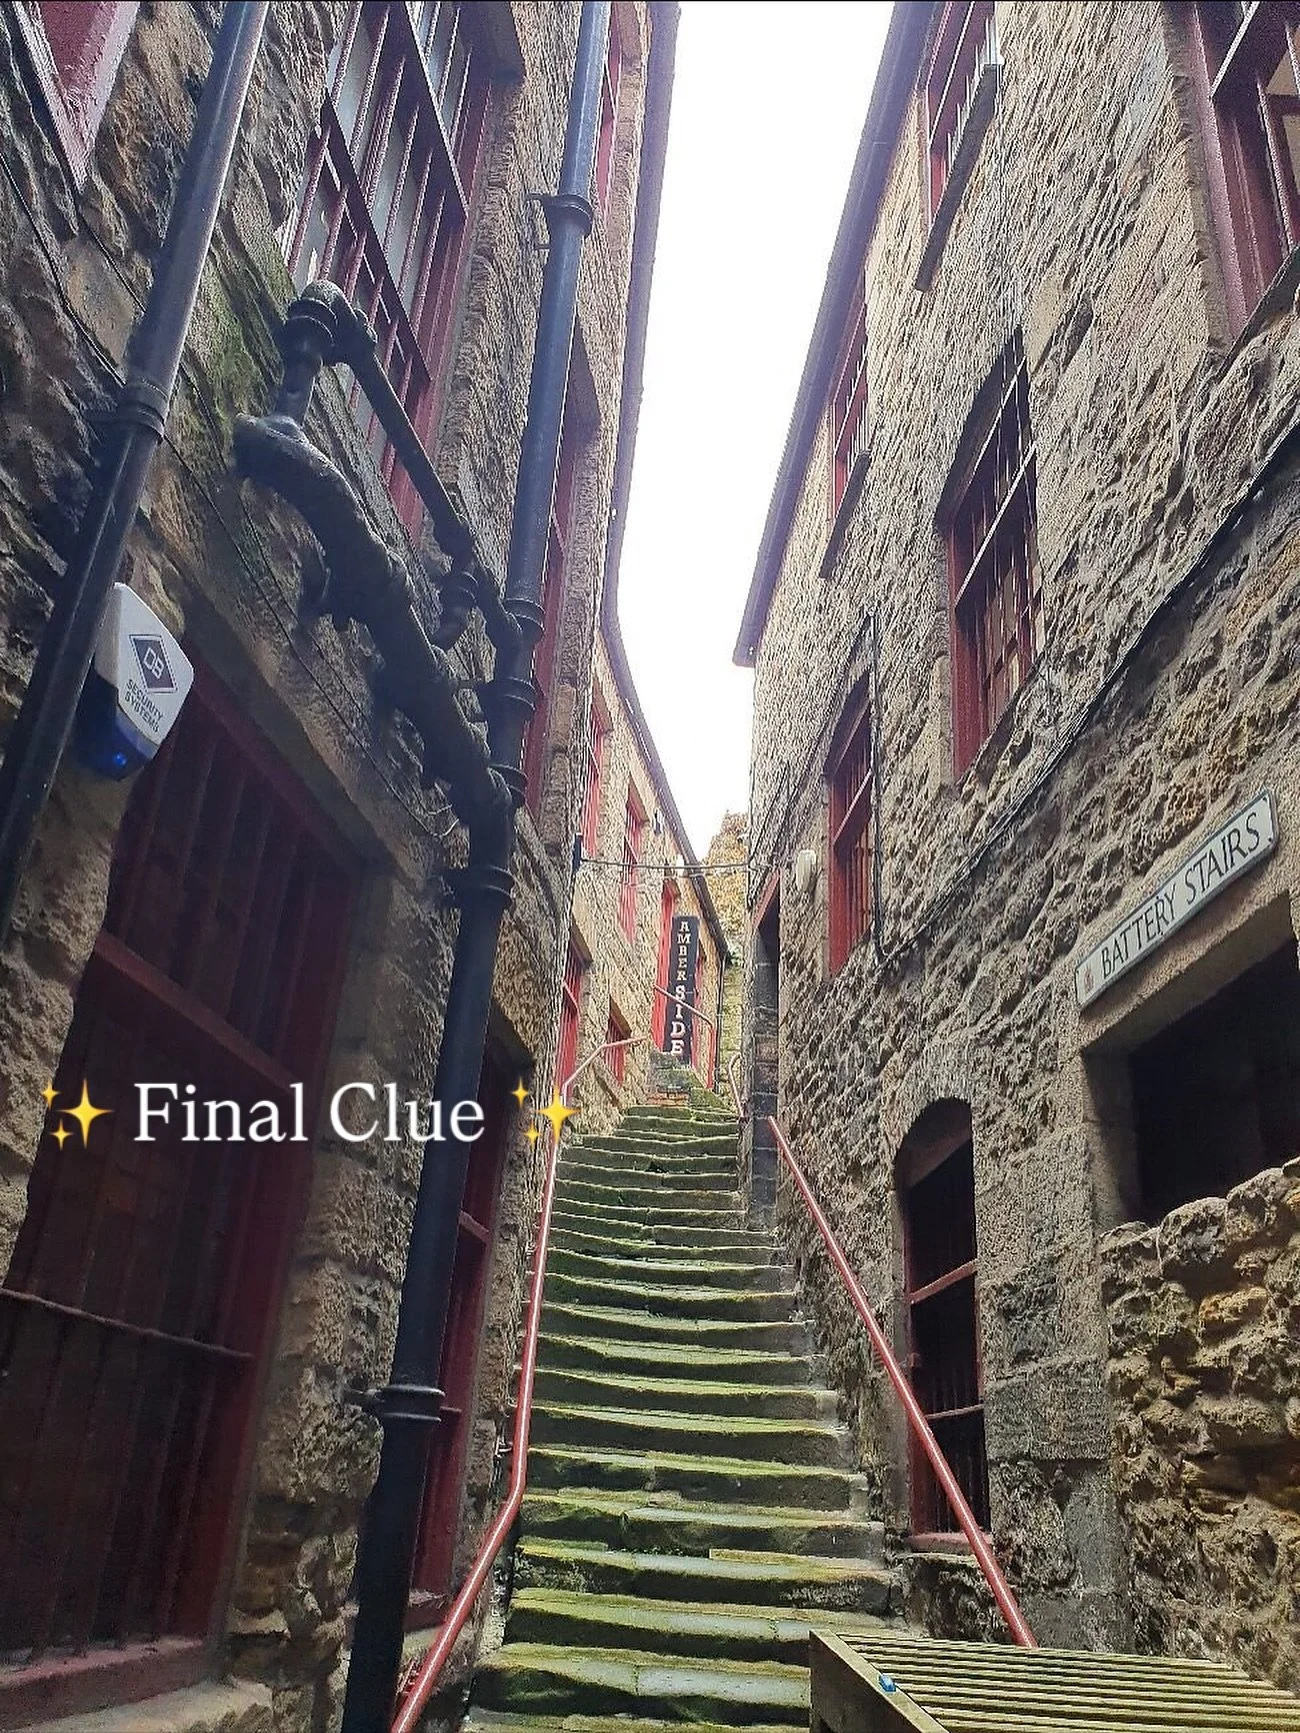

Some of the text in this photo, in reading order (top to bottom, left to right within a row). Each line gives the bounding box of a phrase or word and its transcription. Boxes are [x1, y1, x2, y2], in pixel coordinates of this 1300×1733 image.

[124, 691, 159, 733] SYSTEMS
[126, 679, 164, 720] SECURITY
[1101, 812, 1260, 979] BATTERY STAIRS
